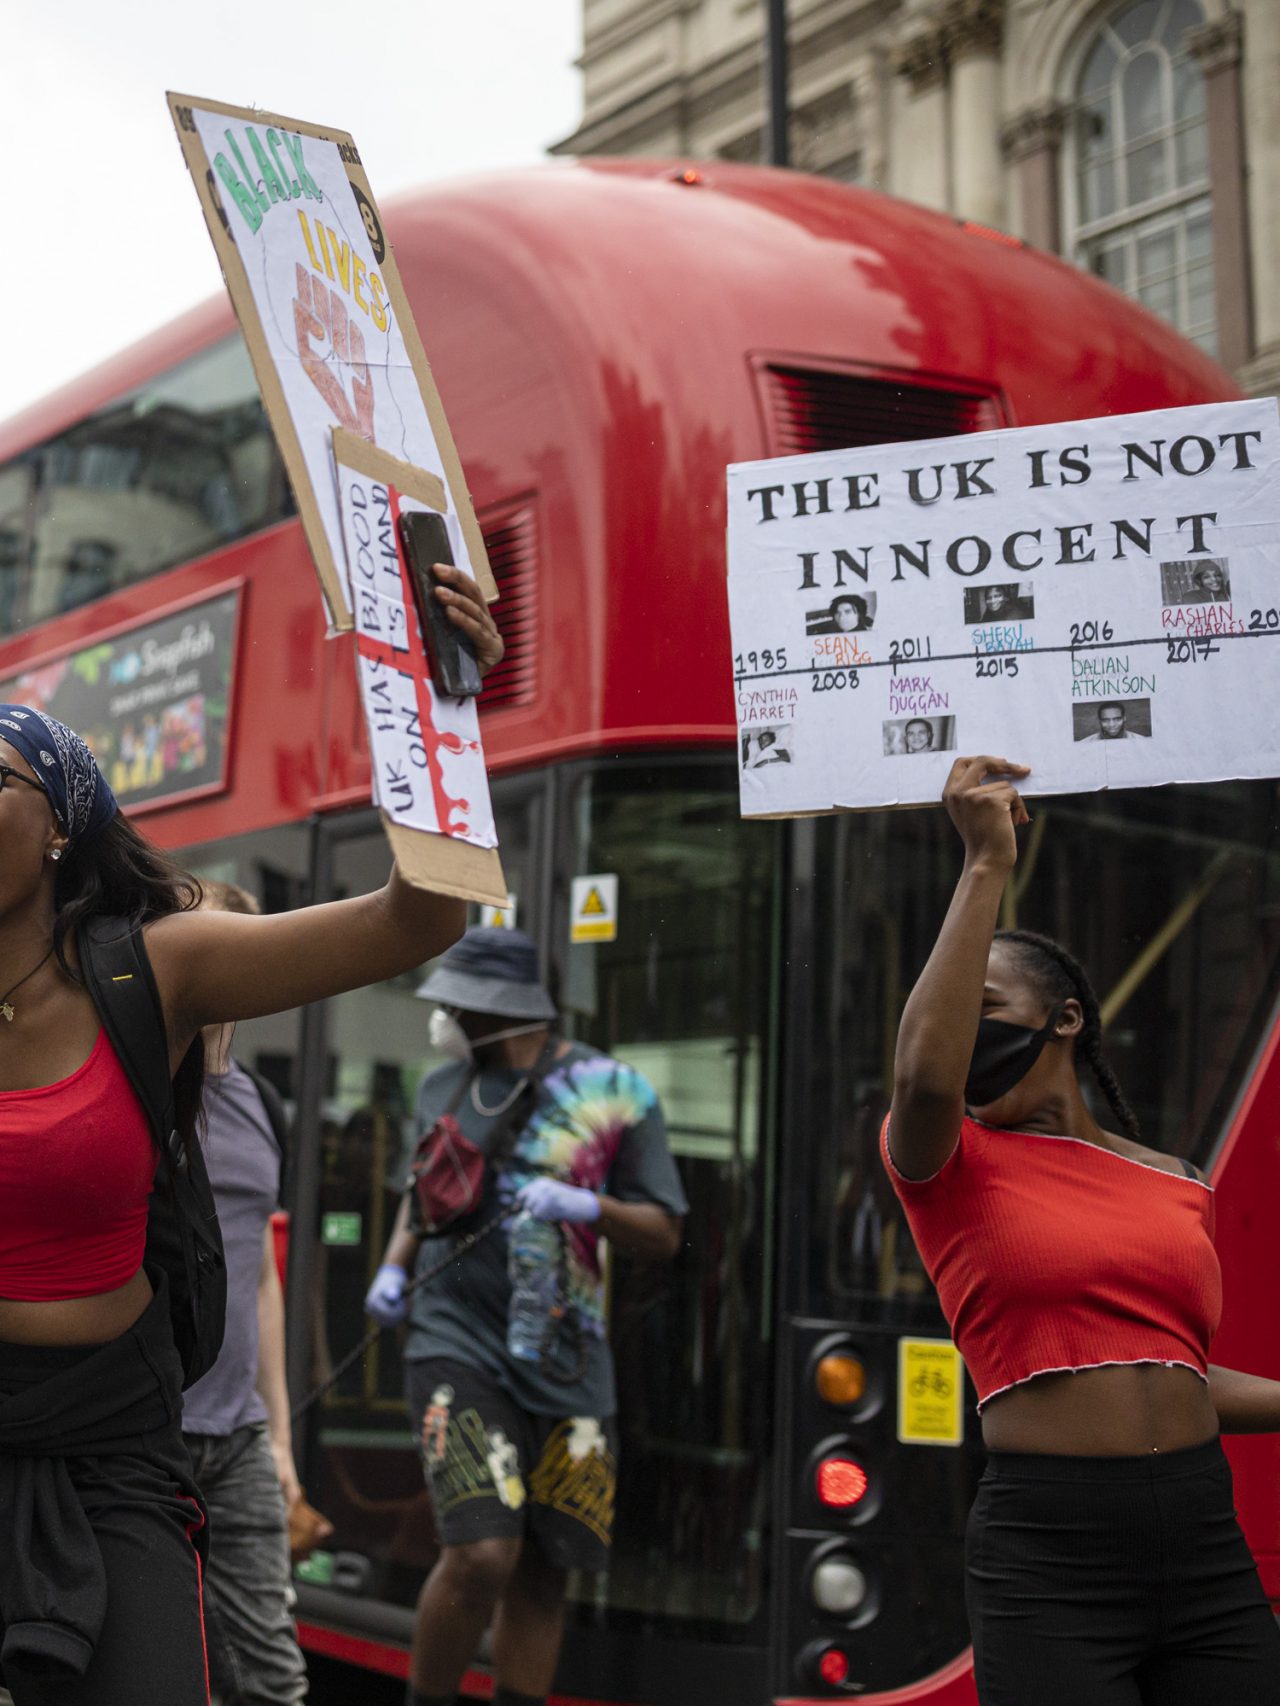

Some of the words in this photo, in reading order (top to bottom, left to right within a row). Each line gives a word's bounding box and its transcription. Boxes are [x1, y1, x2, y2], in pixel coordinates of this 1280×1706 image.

[213, 127, 323, 235] BLACK
[296, 208, 388, 333] LIVES
[747, 472, 880, 525] THE
[902, 457, 997, 505] UK
[1026, 444, 1093, 489] IS
[1121, 430, 1262, 481] NOT
[350, 483, 381, 633] BLOOD
[796, 512, 1219, 590] INNOCENT
[1161, 602, 1233, 628] RASHAN
[1248, 608, 1280, 630] 20
[971, 623, 1023, 644] SHEKU
[1070, 621, 1114, 645] 2016
[814, 636, 860, 656] SEAN
[889, 636, 931, 663] 2011
[1166, 638, 1220, 664] 2017
[734, 648, 788, 674] 1985
[835, 651, 872, 667] RIGG
[975, 657, 1019, 678] 2015
[1071, 655, 1130, 677] DALIAN
[812, 669, 860, 692] 2008
[889, 676, 933, 693] MARK
[1071, 674, 1156, 697] ATKINSON
[737, 687, 799, 706] CYNTHIA
[889, 692, 949, 715] DUGGAN
[739, 703, 797, 724] JARRET
[386, 759, 414, 813] UK
